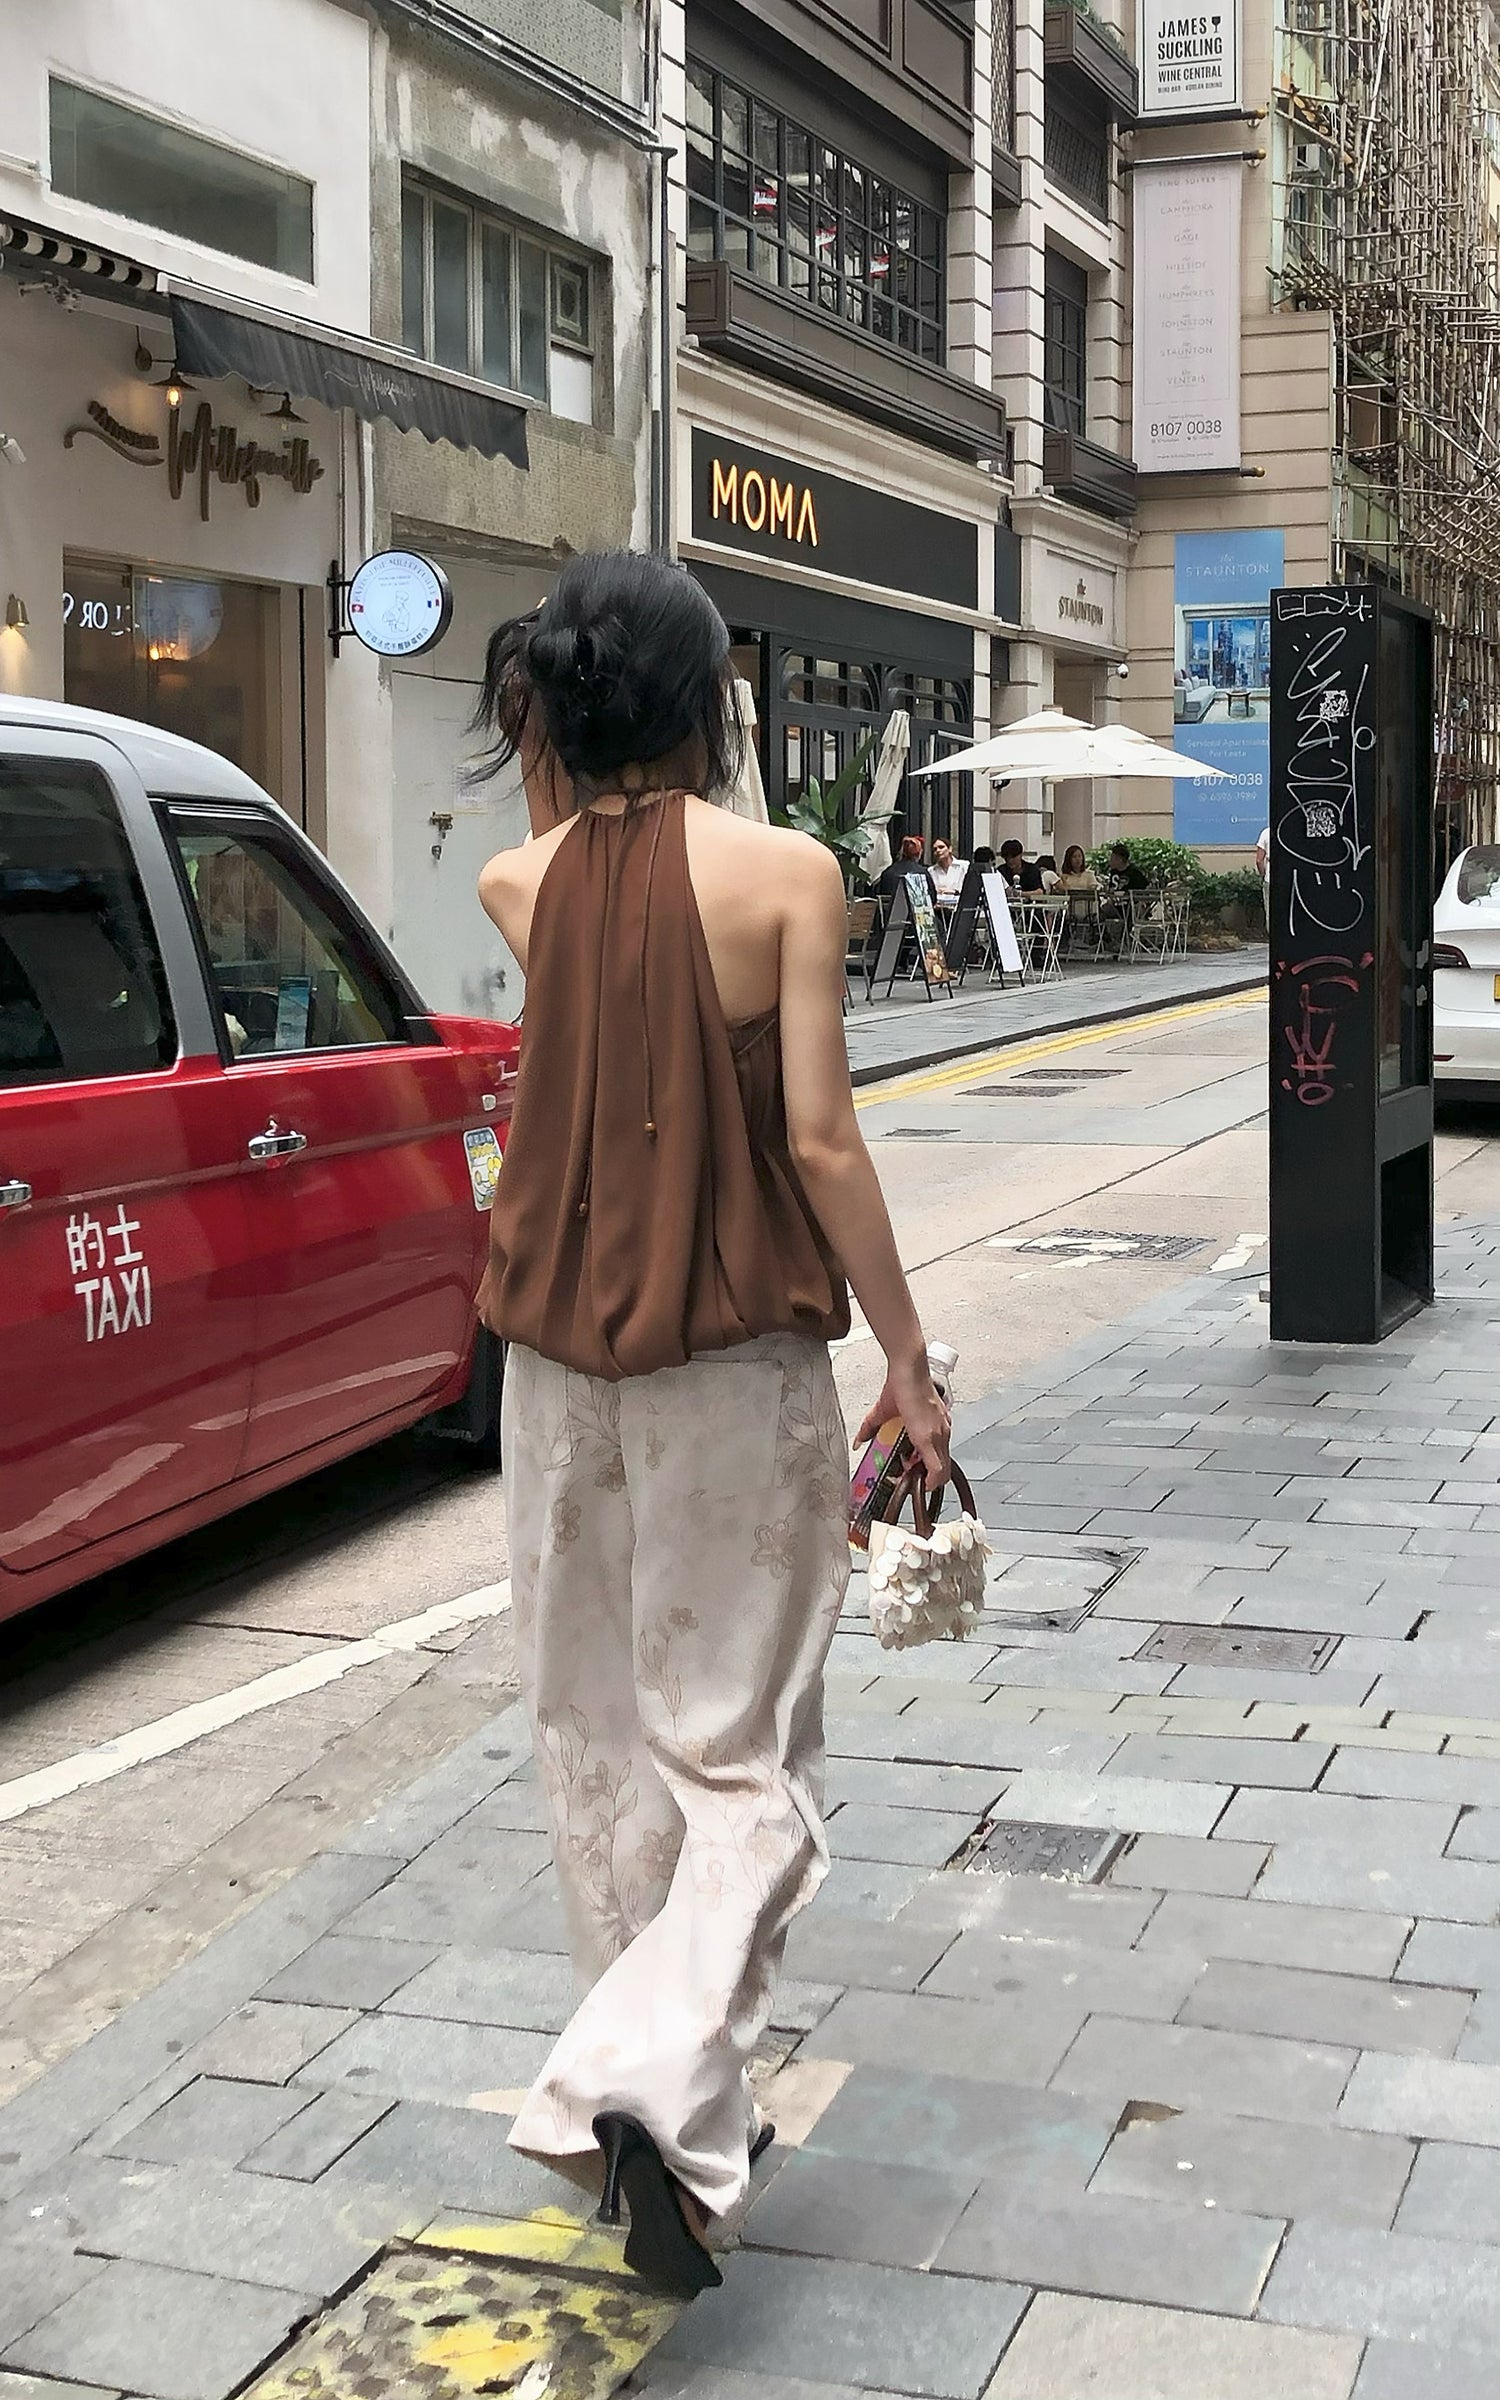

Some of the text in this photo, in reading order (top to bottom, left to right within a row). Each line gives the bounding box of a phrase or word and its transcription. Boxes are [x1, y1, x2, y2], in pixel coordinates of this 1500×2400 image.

[1158, 17, 1207, 38] JAMES
[1158, 37, 1222, 60] SUCKLING
[1158, 65, 1222, 82] WINE CENTRAL
[1160, 346, 1213, 357] STAUNTON
[1150, 419, 1222, 437] 8107 0038
[711, 458, 819, 547] MOMA
[1185, 563, 1270, 577] STAUNTON
[1058, 596, 1104, 626] STAUNTON
[1230, 773, 1263, 786] 0038
[66, 1204, 143, 1274] 的士
[75, 1266, 151, 1342] TAXI
